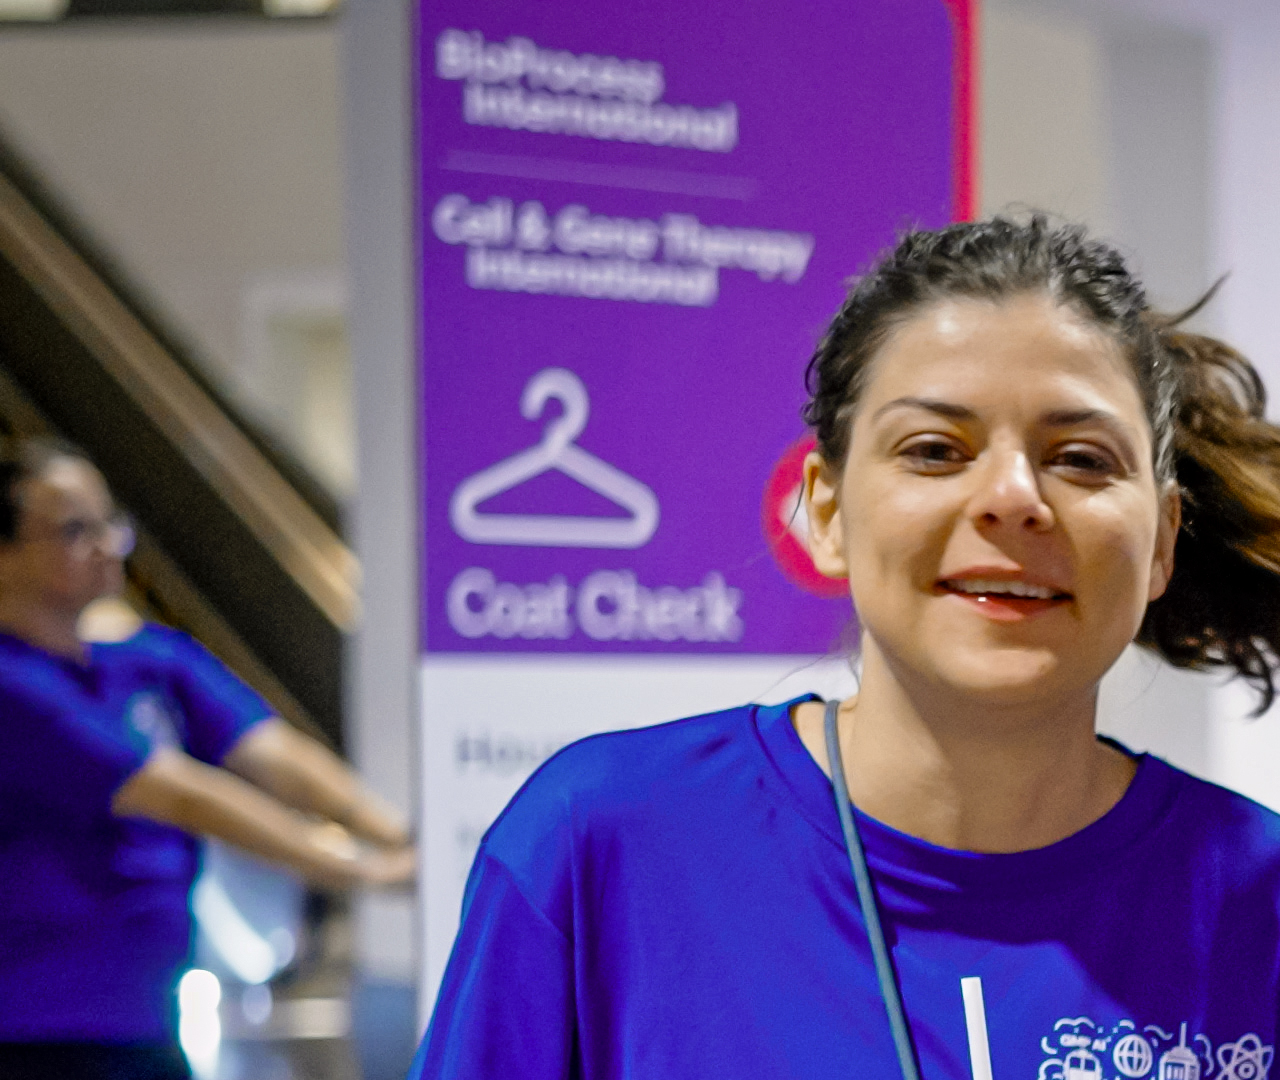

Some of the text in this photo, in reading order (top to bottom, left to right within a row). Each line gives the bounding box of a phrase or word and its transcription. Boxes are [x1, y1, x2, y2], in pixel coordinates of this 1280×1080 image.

[436, 27, 664, 103] BioProcess
[462, 83, 738, 152] International
[432, 192, 815, 283] Cell & Gene Therapy
[465, 249, 719, 306] International
[447, 566, 744, 642] Coat Check
